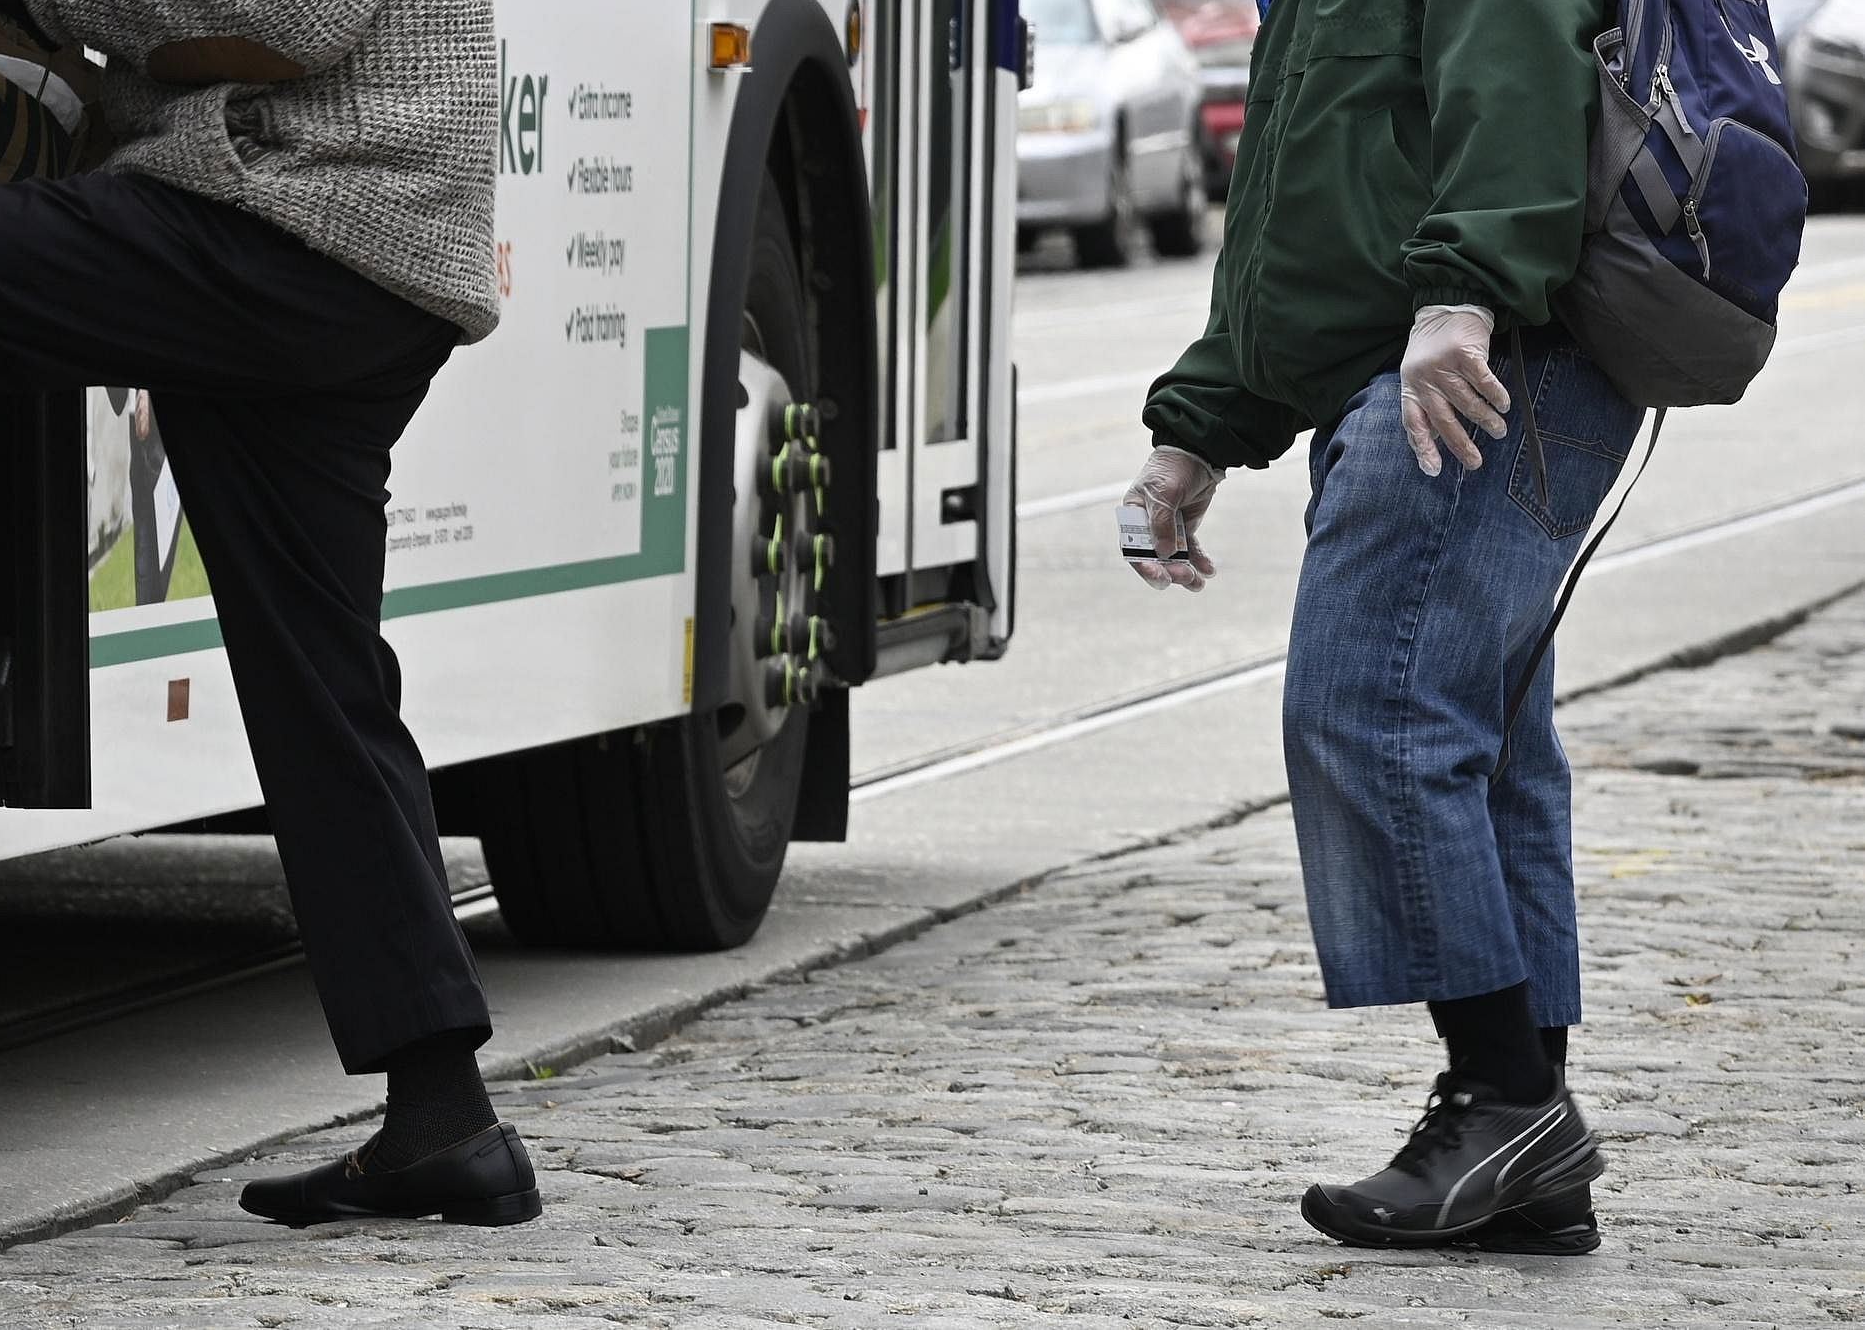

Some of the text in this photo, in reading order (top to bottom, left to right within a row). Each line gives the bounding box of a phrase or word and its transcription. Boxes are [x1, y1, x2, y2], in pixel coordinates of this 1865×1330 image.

[499, 38, 548, 175] ker
[578, 81, 632, 119] Extra income
[578, 155, 632, 193] Flexible hours
[577, 230, 625, 276] Weekly pay
[576, 302, 625, 349] Paid training
[651, 414, 679, 456] Census
[654, 455, 674, 496] 2020
